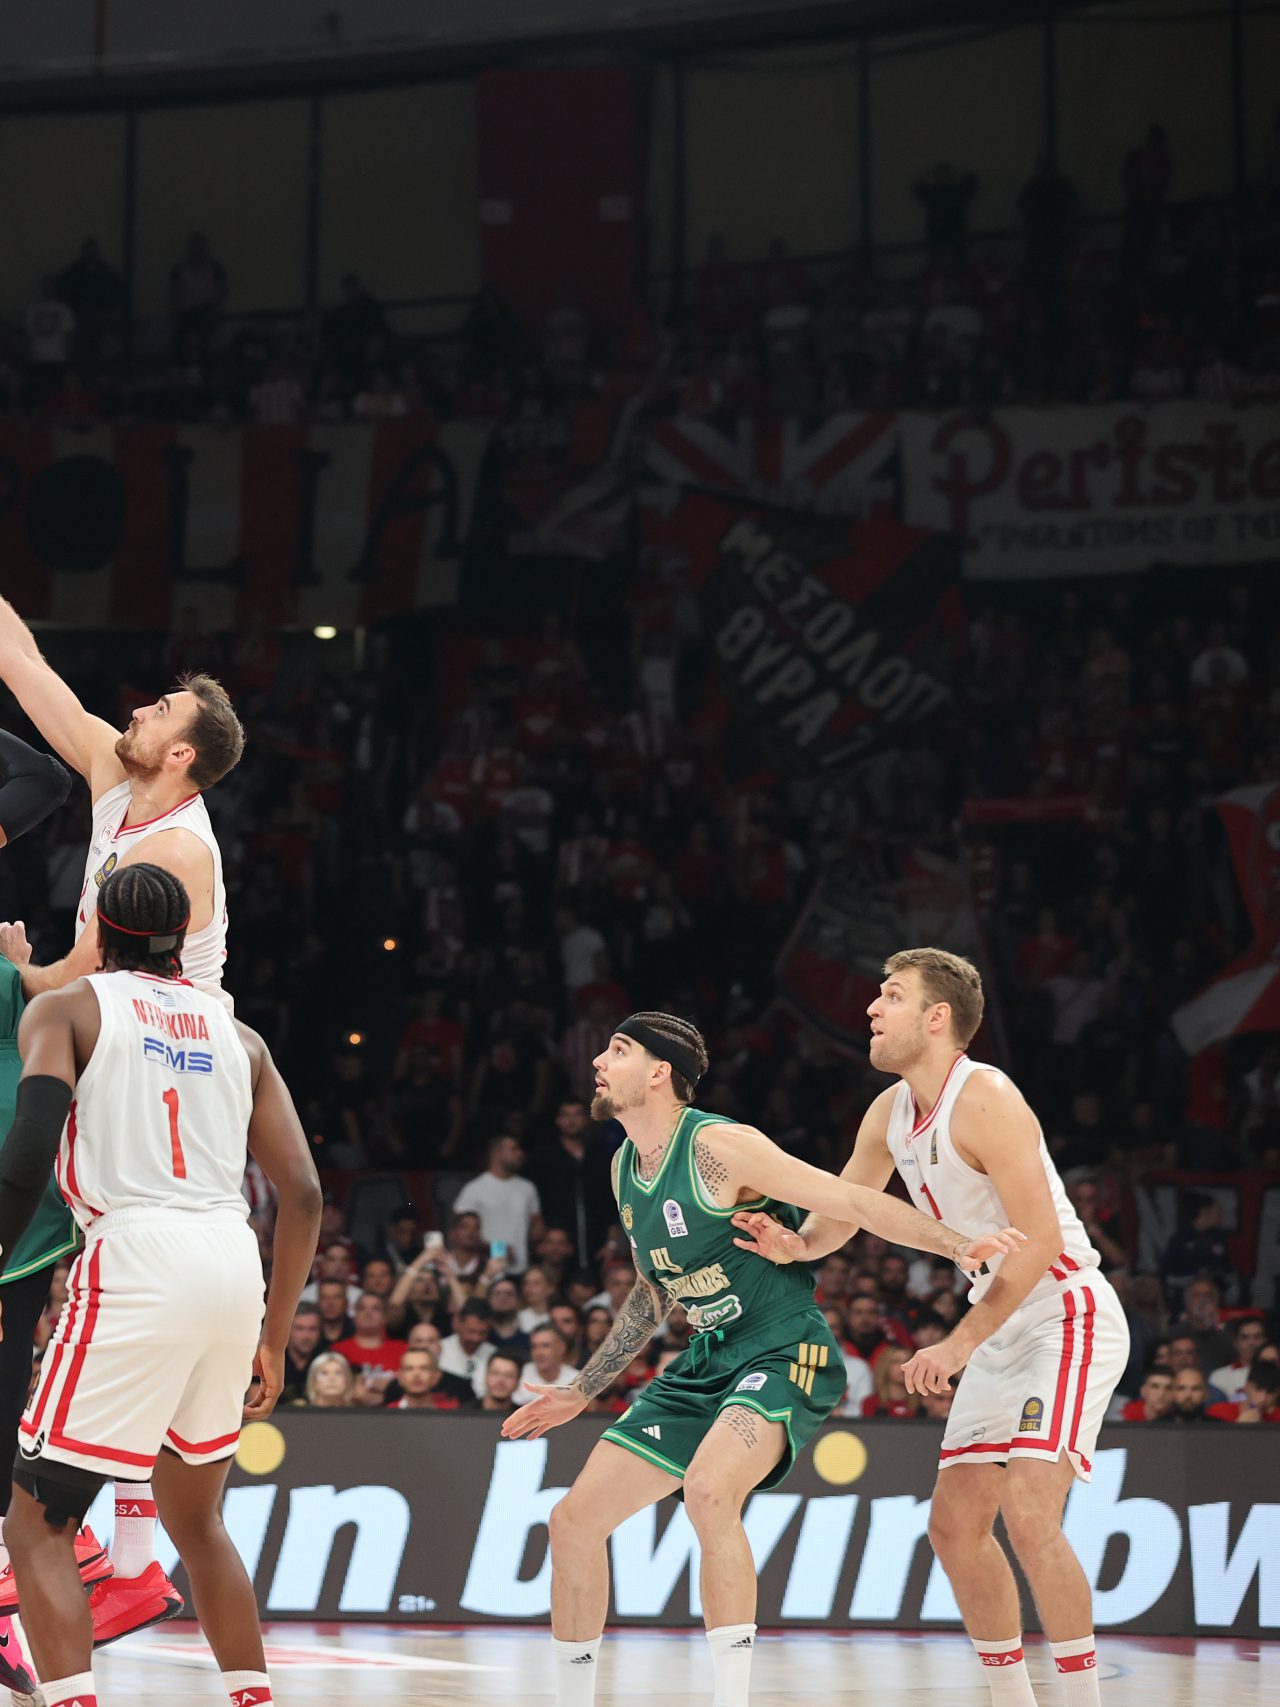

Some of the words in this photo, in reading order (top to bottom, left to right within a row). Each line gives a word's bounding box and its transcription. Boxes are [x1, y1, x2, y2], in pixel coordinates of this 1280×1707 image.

[162, 1087, 187, 1180] 1
[670, 1226, 686, 1235] GBL
[1020, 1422, 1039, 1431] GBL
[980, 1655, 1017, 1665] GSA
